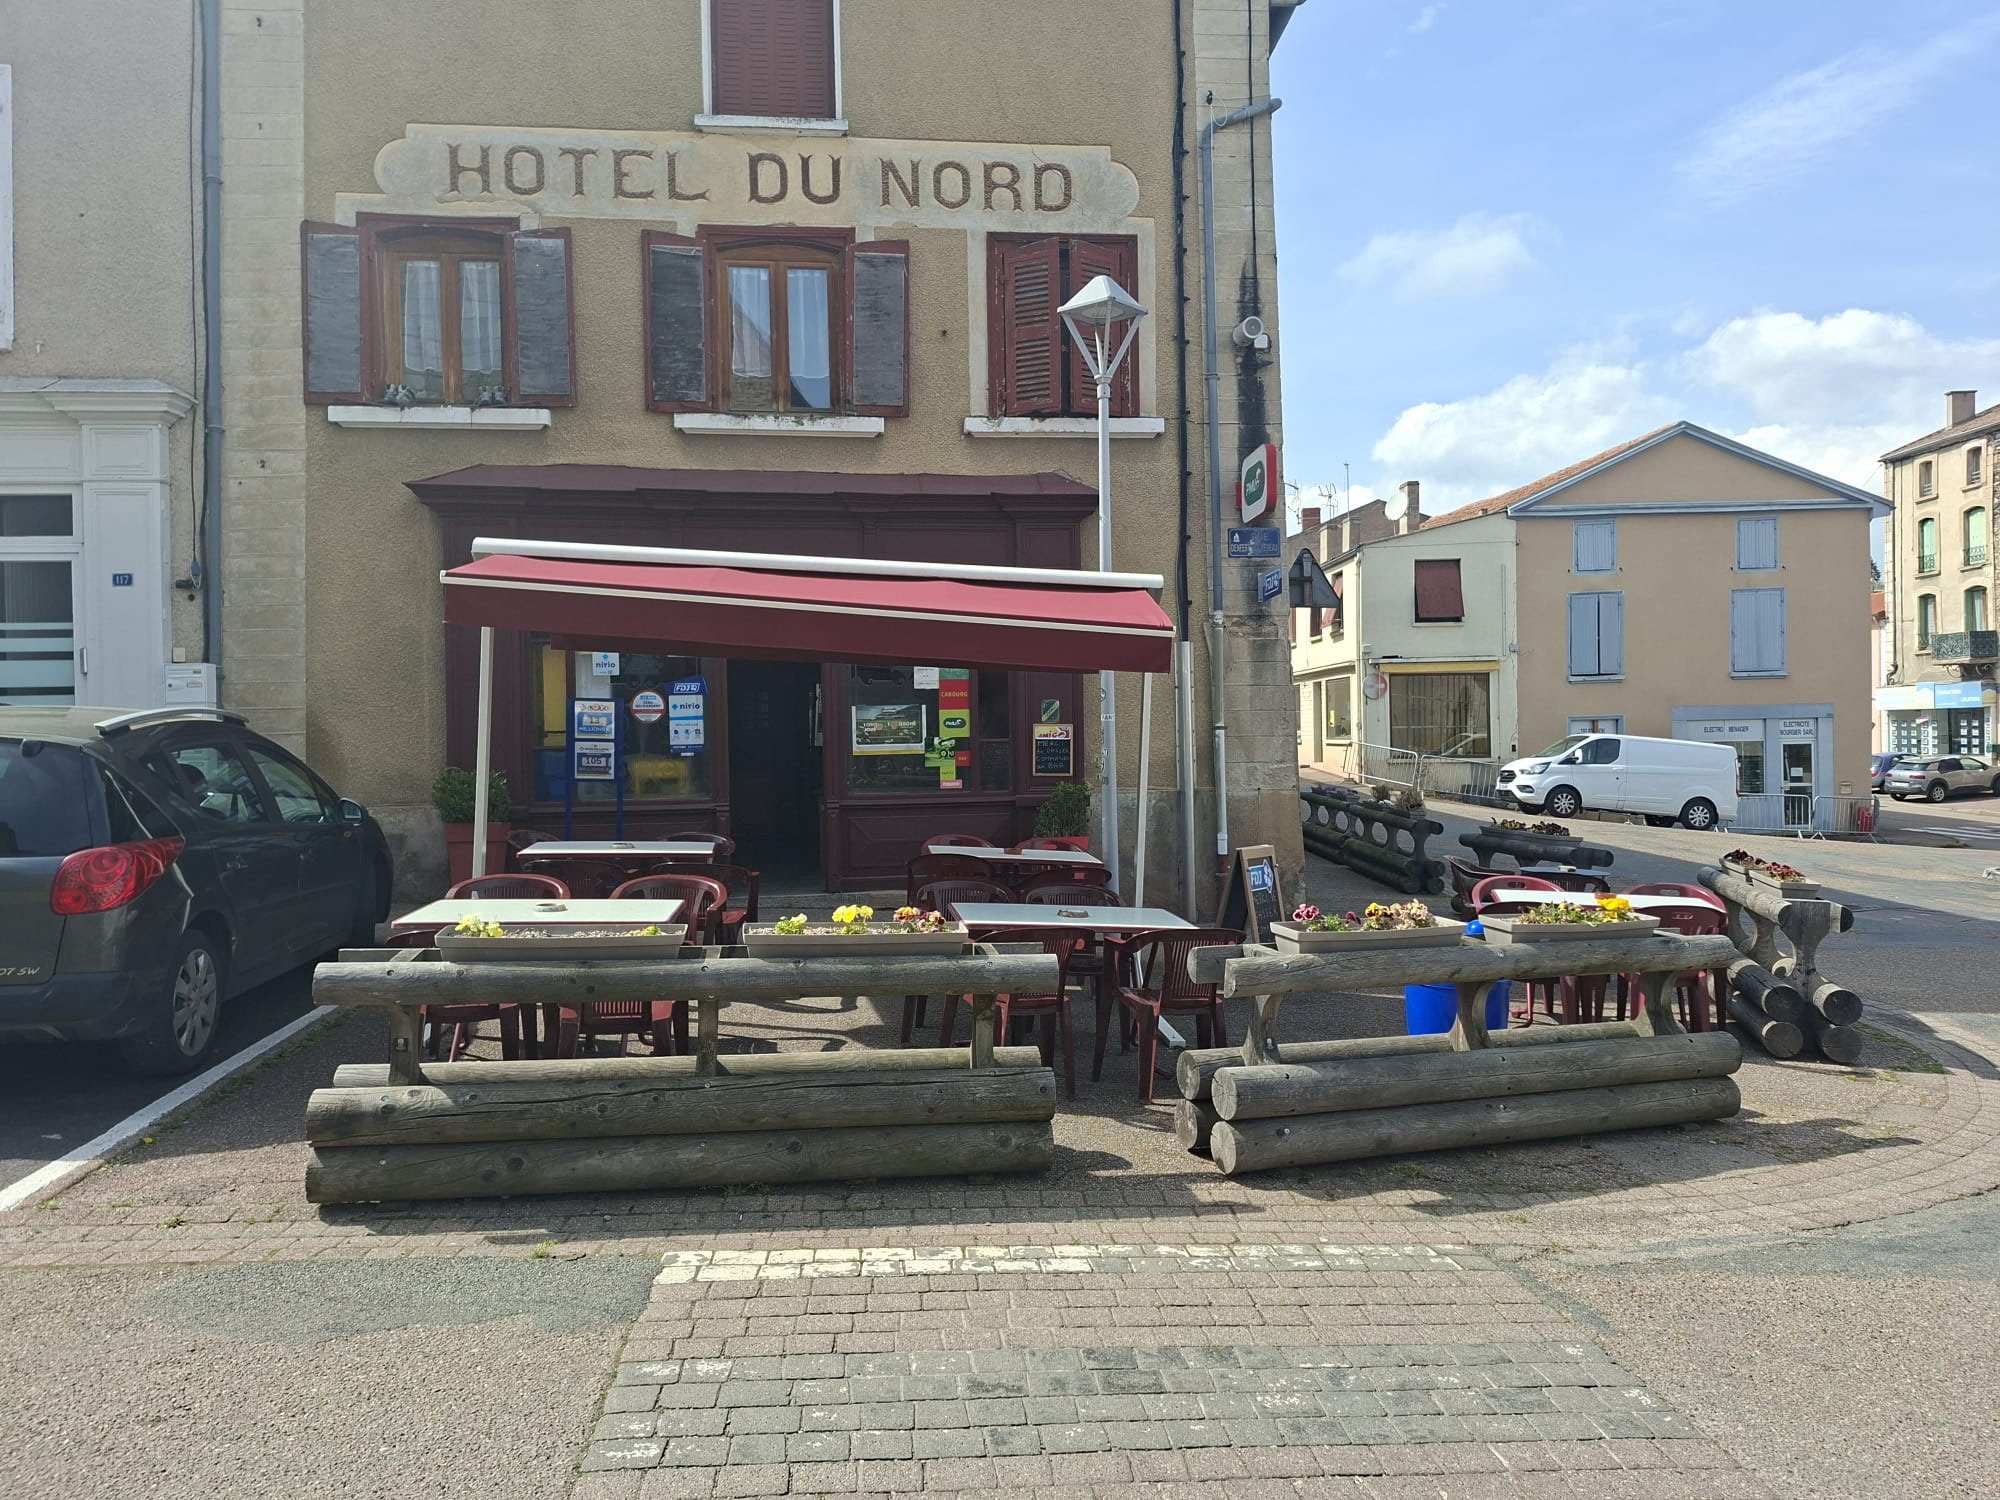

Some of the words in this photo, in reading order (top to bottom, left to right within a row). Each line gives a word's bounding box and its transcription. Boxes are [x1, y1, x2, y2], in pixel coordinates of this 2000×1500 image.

[446, 143, 711, 201] HOTEL
[748, 152, 842, 205] DU
[879, 158, 1073, 212] NORD
[115, 575, 130, 585] 117
[595, 660, 616, 669] nirio
[679, 702, 701, 710] nirio
[1250, 870, 1263, 886] FDJ
[16, 966, 41, 976] SW
